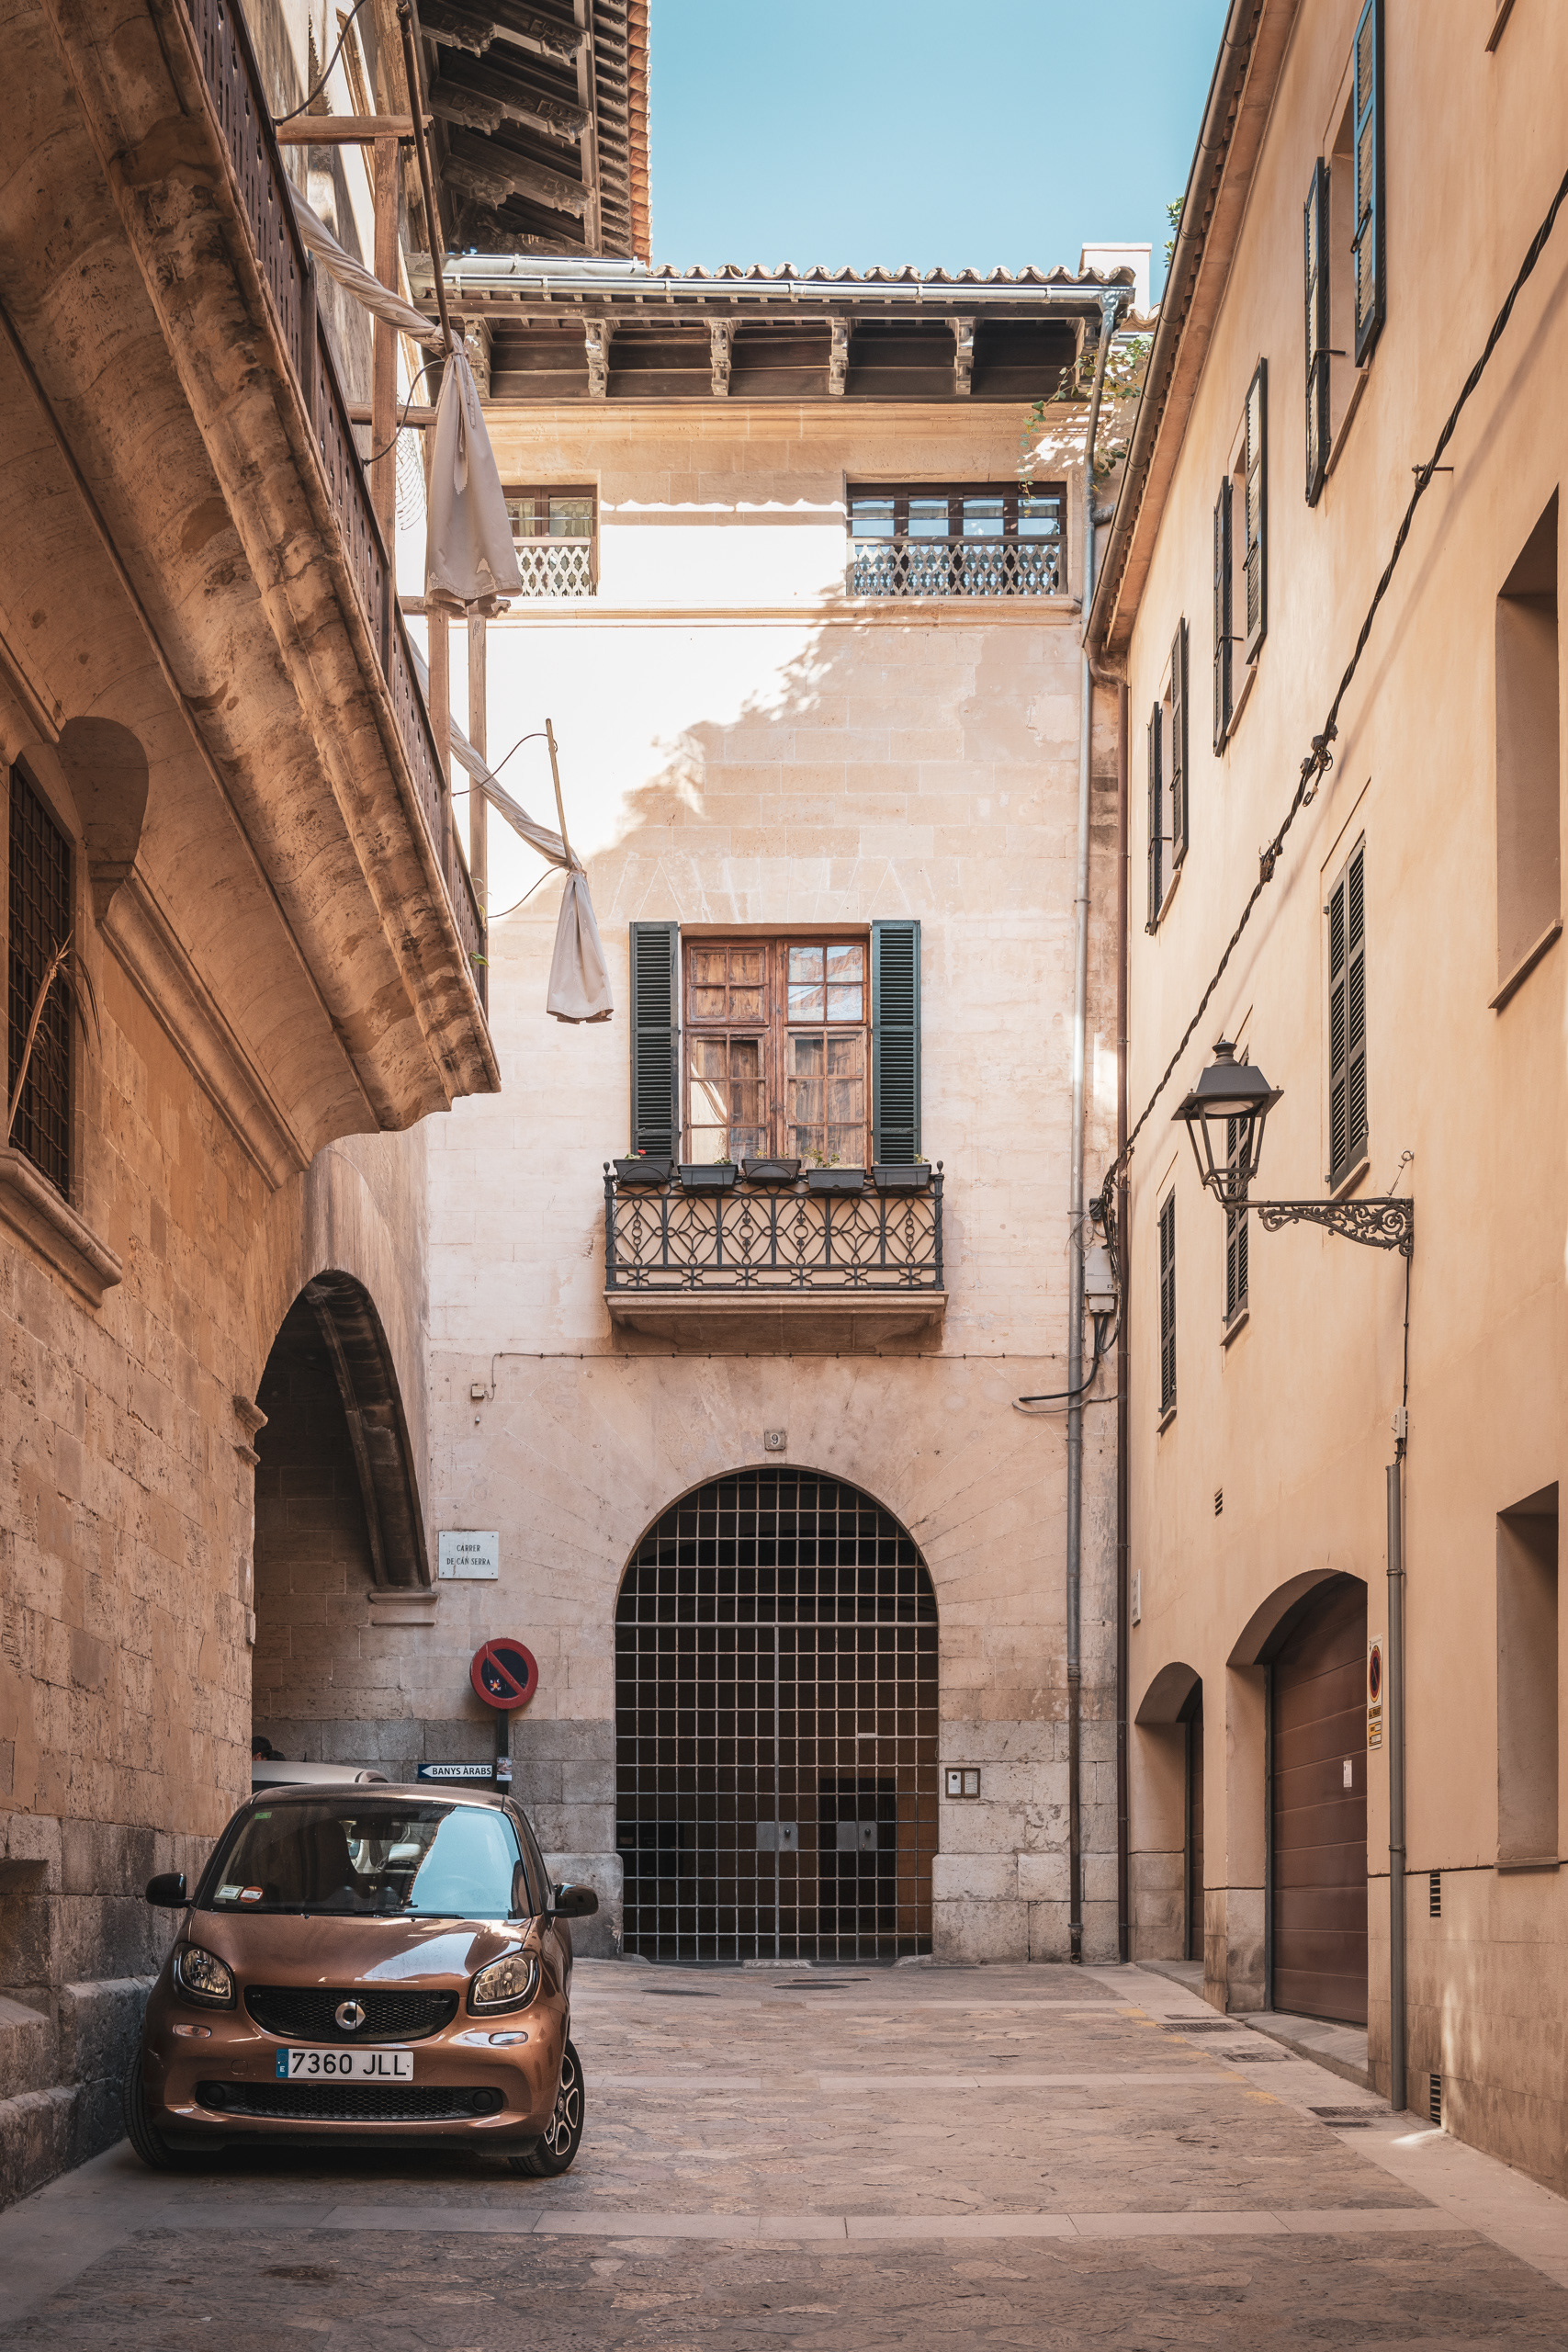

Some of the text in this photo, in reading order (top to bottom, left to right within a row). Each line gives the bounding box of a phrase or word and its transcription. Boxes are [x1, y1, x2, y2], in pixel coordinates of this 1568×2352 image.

[771, 1433, 779, 1445] 9
[432, 1766, 491, 1775] BANYS ÀRABS
[292, 2052, 407, 2076] 7360 JLL
